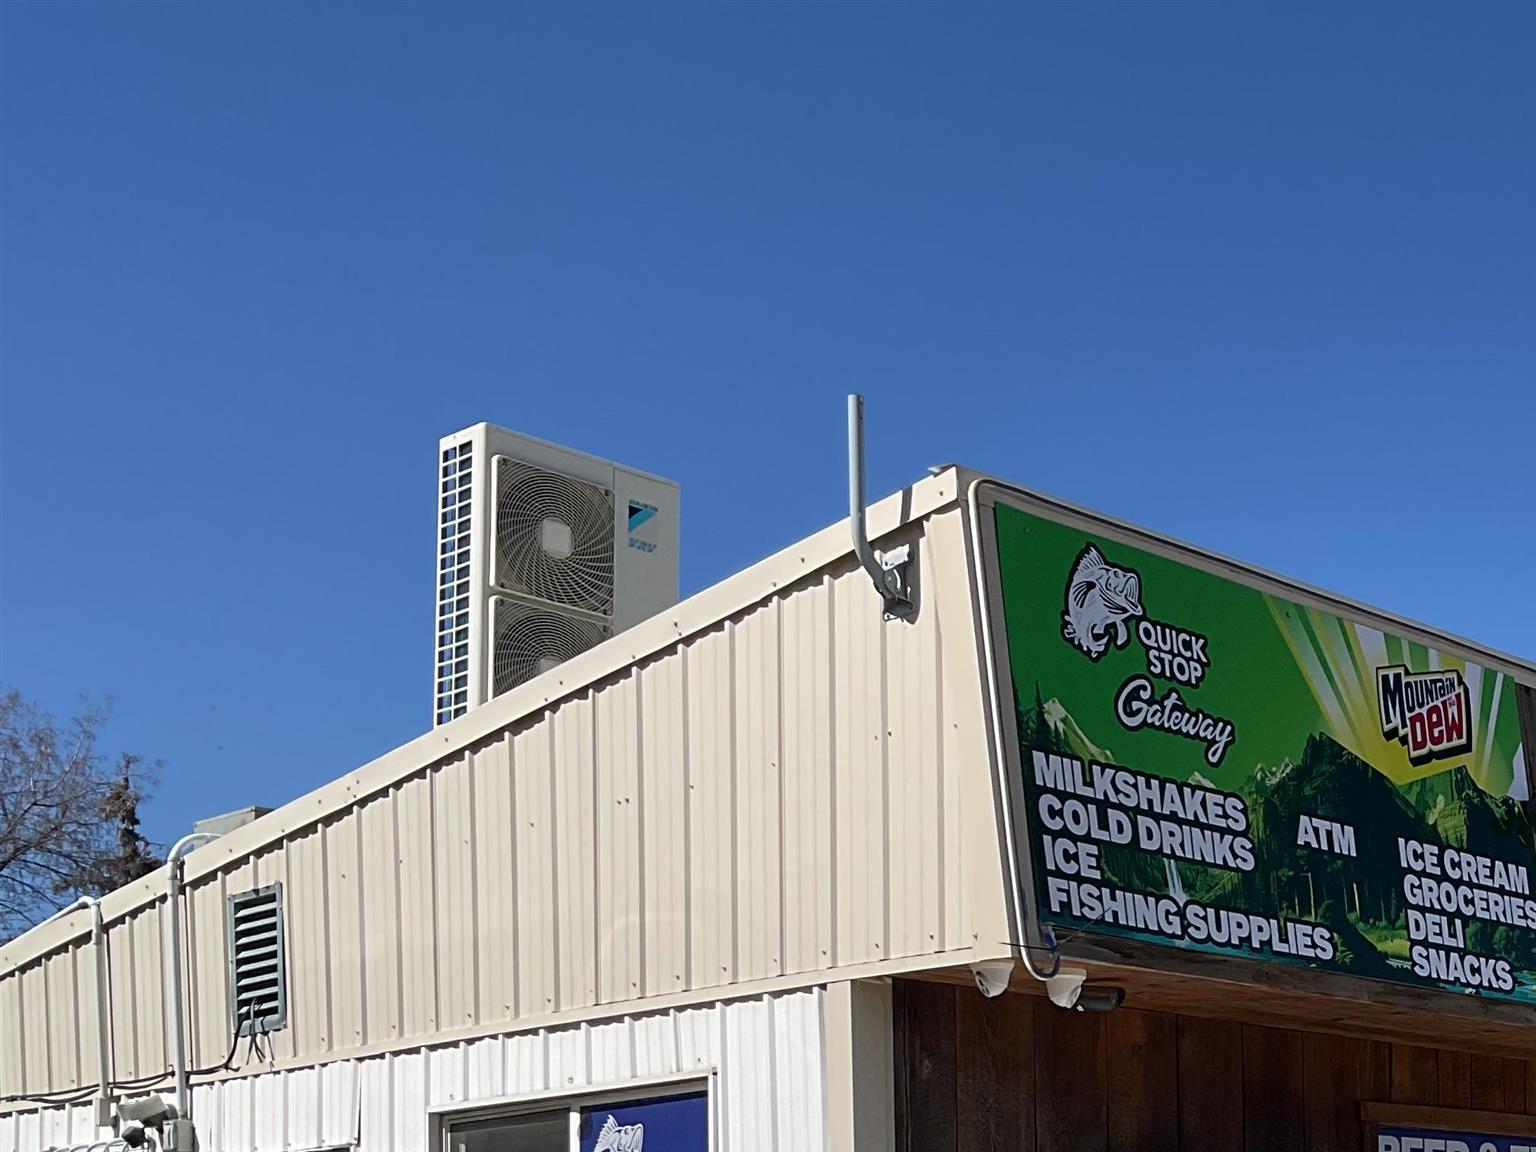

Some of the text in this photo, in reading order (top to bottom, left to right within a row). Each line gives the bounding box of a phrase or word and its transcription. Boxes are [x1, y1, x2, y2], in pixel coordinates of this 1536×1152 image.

[1138, 621, 1207, 661] QUICK
[1150, 650, 1202, 684] STOP
[1118, 679, 1233, 763] Gateway
[1033, 751, 1247, 832] MILKSHAKES
[1038, 794, 1255, 871] COLD DRINKS
[1297, 815, 1357, 858] ATM
[1043, 836, 1099, 878] ICE
[1399, 837, 1529, 895] ICE CREAM
[1050, 878, 1334, 960] FISHING SUPPLIES
[1408, 910, 1464, 949] DELI
[1411, 946, 1514, 992] SNACKS
